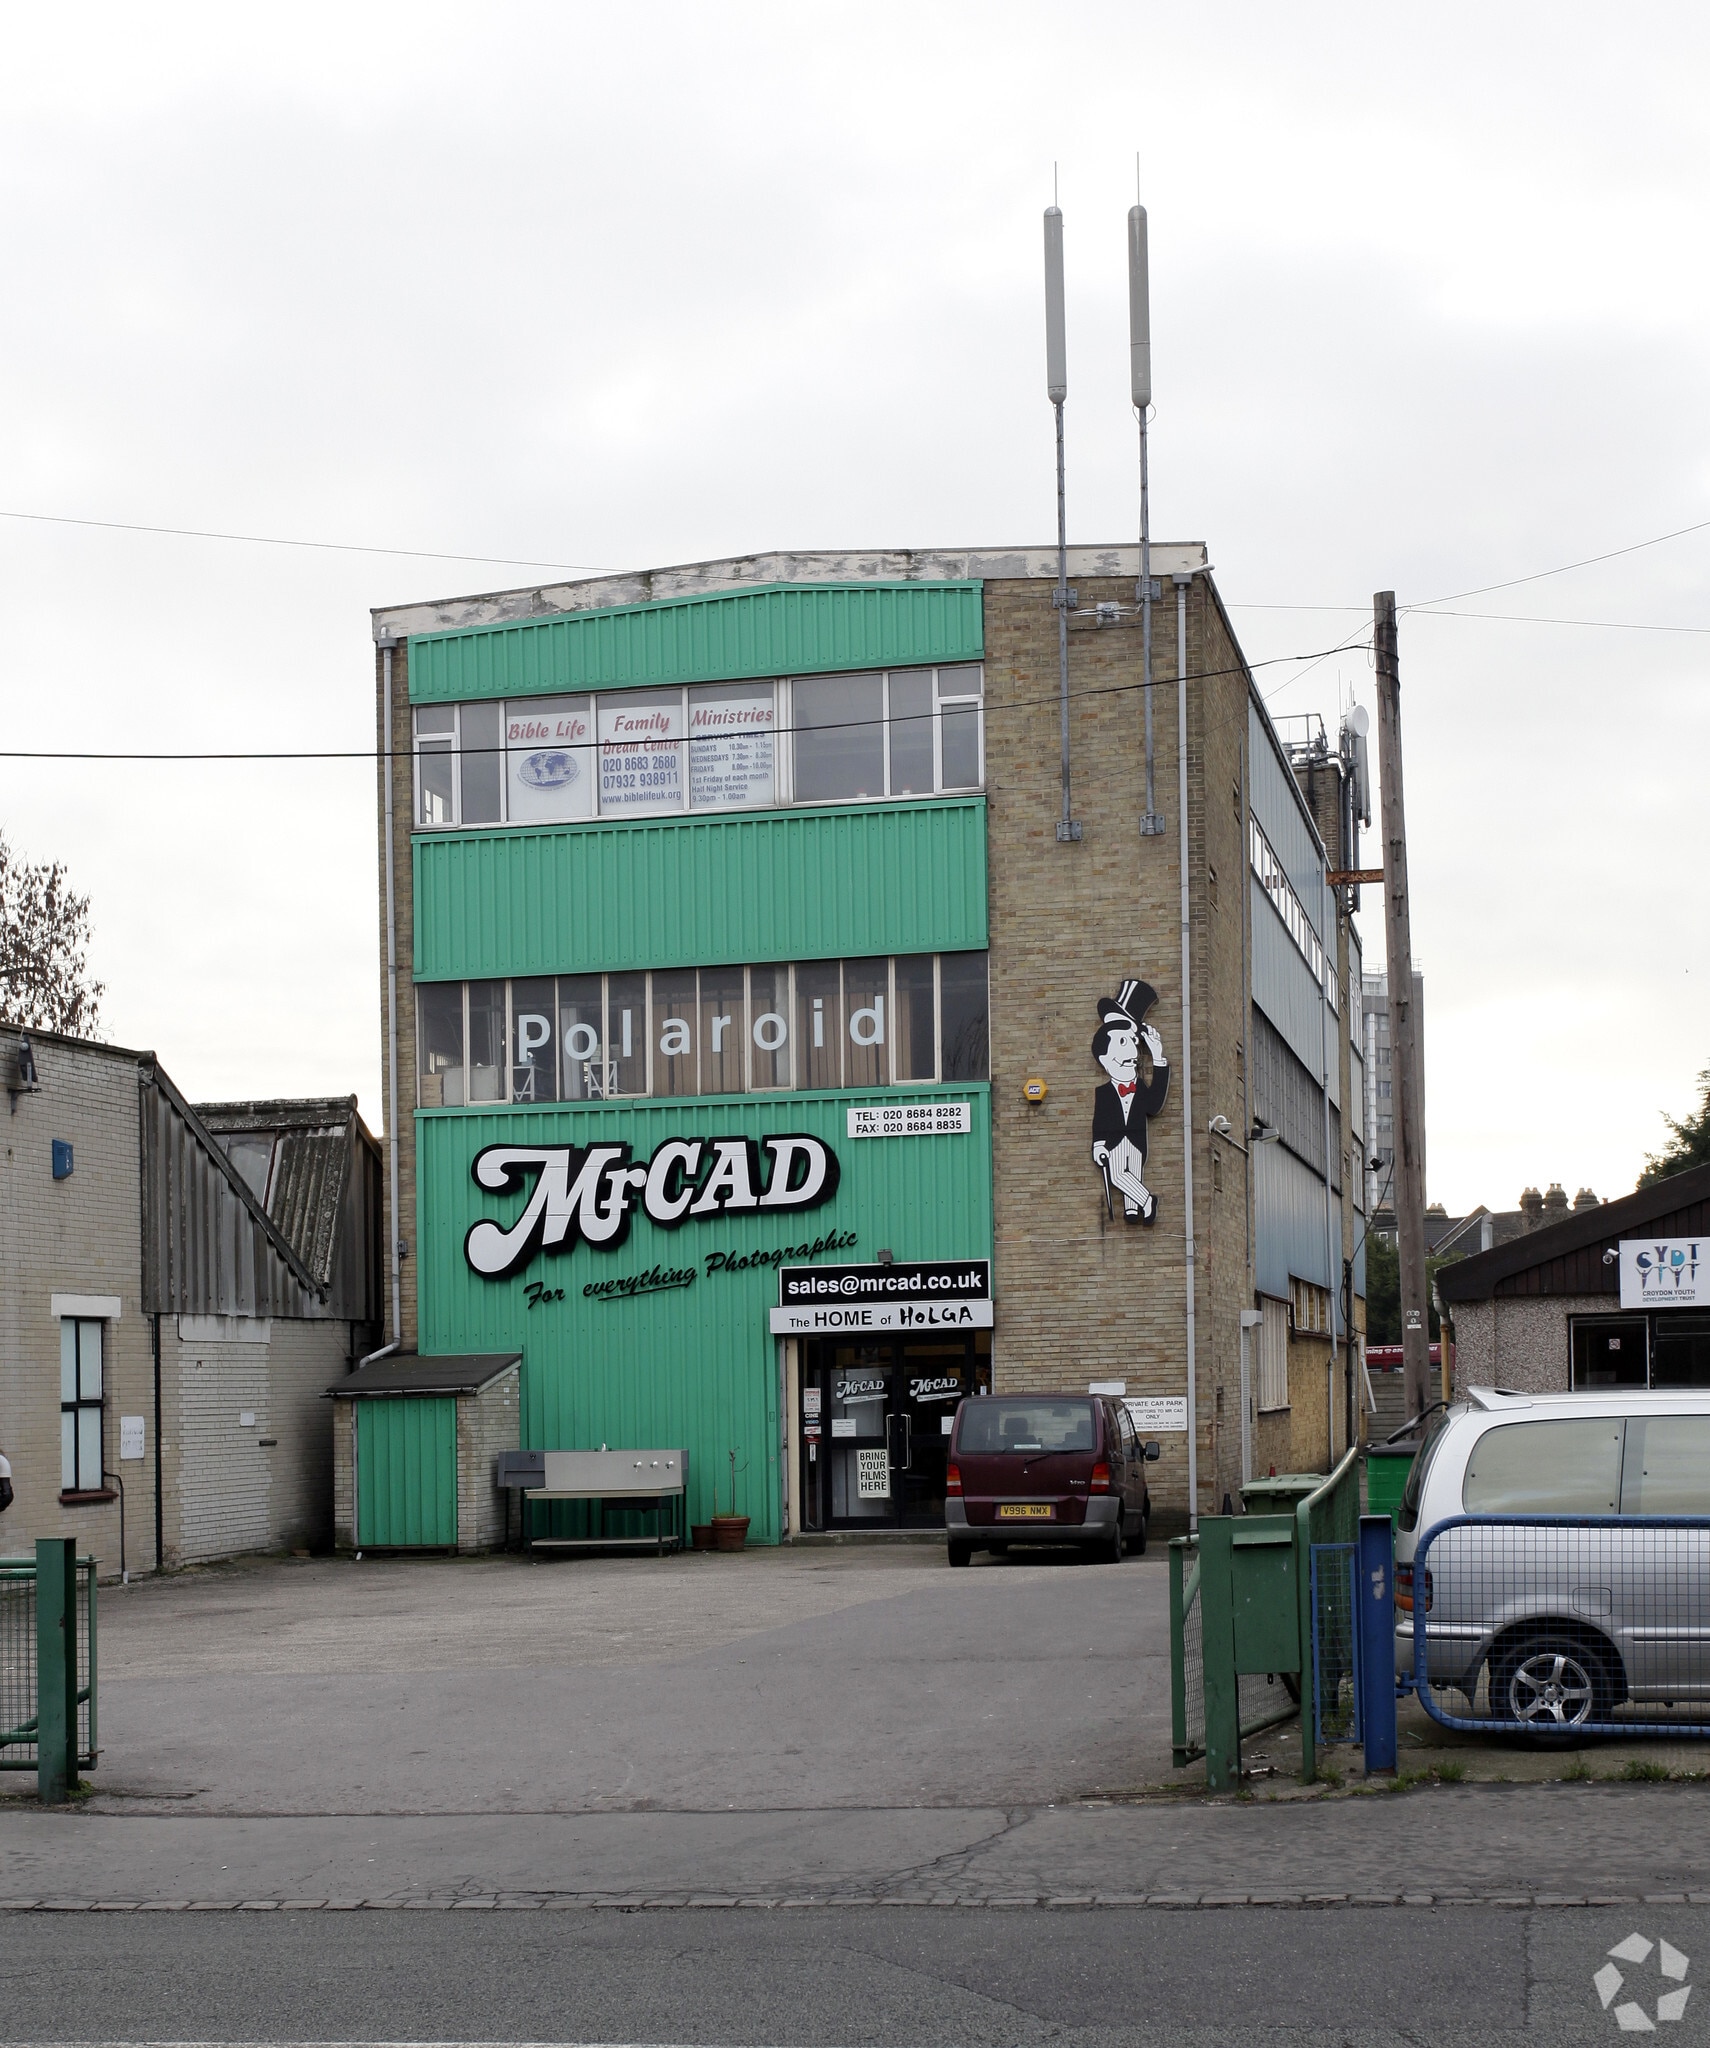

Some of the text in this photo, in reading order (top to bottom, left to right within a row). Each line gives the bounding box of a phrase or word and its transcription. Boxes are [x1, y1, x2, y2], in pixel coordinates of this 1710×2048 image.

[614, 712, 670, 733] Family
[691, 707, 773, 726] Ministries
[508, 719, 585, 740] Bible Life
[603, 735, 680, 755] Dream Centre
[691, 744, 717, 753] SUNDAYS
[603, 755, 677, 772] 020 8683 2680
[691, 753, 729, 763] WEDNESDAYS
[691, 764, 714, 773] FRIDAYS
[603, 771, 679, 789] 07932 938911
[703, 775, 722, 784] Friday
[732, 773, 748, 781] each
[749, 772, 769, 780] month
[706, 784, 722, 793] Night
[724, 783, 748, 791] Service
[601, 790, 681, 804] www.biblelifeuk.org
[518, 996, 884, 1062] Polaroid
[855, 1107, 962, 1121] TEL: 020 8684 8282
[856, 1120, 962, 1133] FAX: 020 8684 8835
[523, 1228, 859, 1310] For everything Photographic
[788, 1271, 982, 1296] sales@mrcad.co.uk
[789, 1317, 810, 1328] The
[815, 1310, 873, 1327] HOME
[880, 1314, 892, 1325] of
[860, 1451, 886, 1461] BRING
[860, 1461, 886, 1470] YOUR
[860, 1470, 886, 1480] FILMS
[861, 1481, 887, 1490] HERE
[1003, 1506, 1048, 1515] V996 NMX
